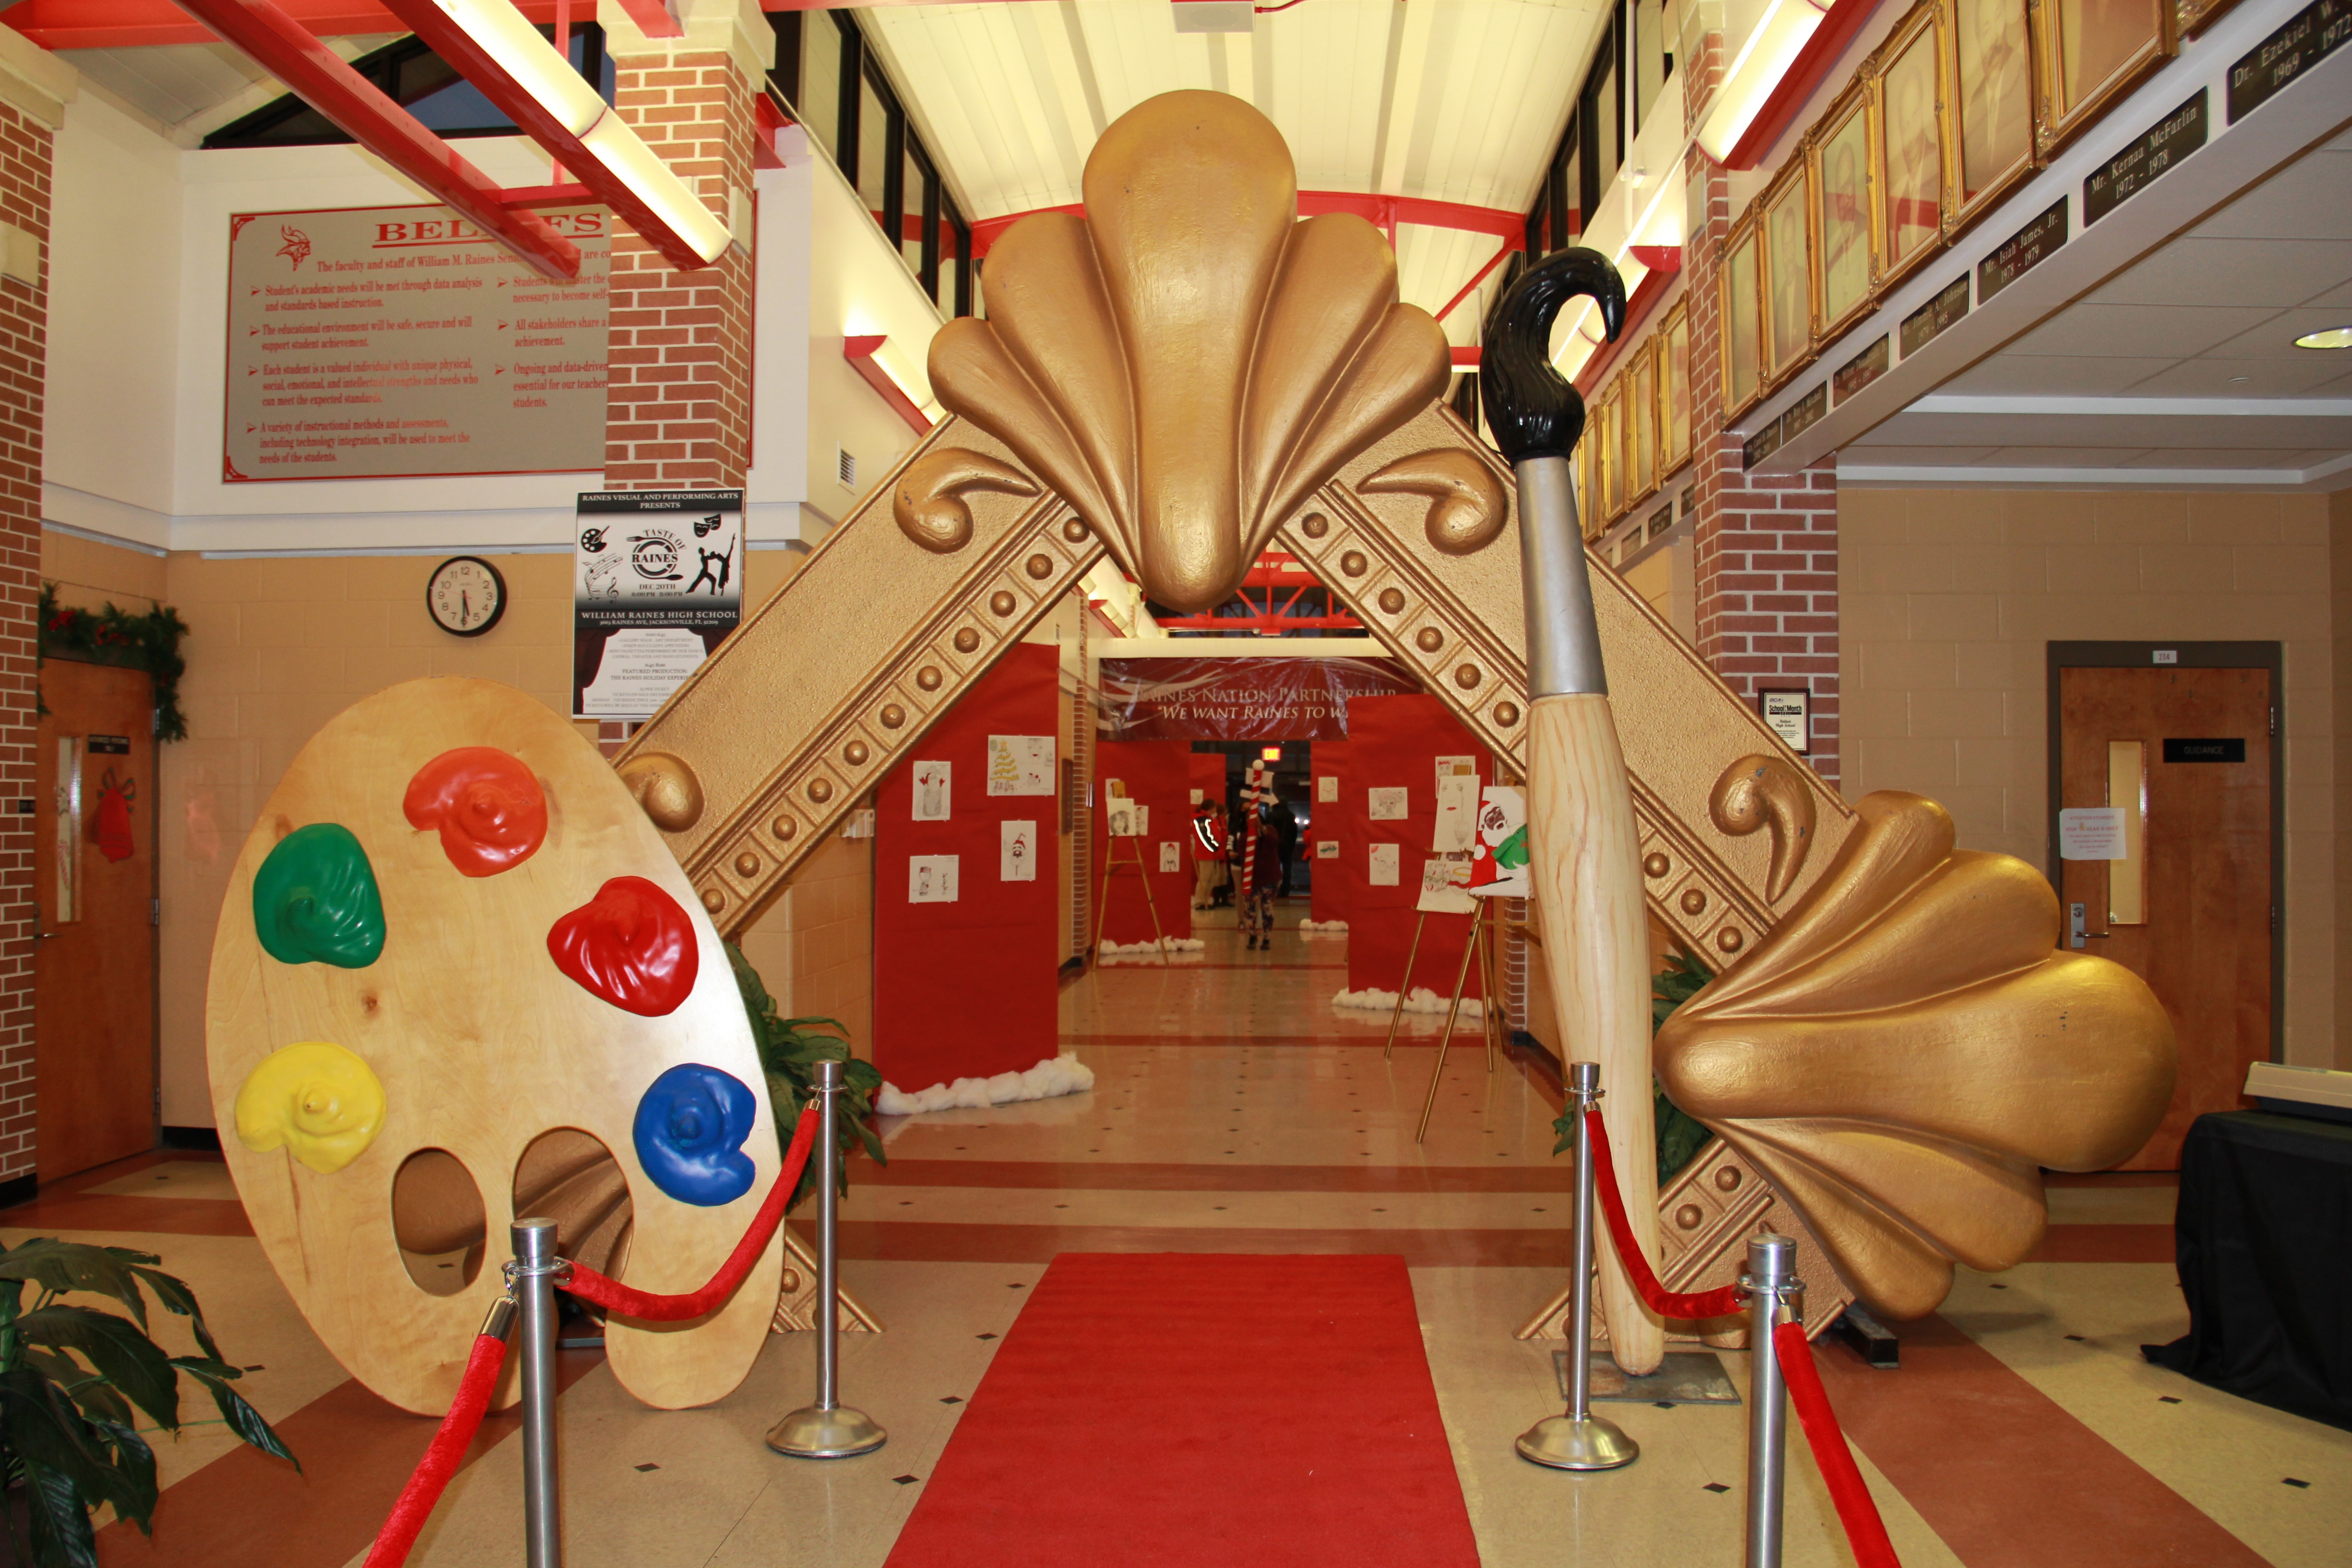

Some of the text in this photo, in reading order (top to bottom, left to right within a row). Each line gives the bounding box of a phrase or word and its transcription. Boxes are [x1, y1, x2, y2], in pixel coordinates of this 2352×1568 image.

[2234, 67, 2253, 88] Dr.
[2261, 15, 2311, 68] Ezekiel
[2273, 13, 2352, 86] 1969 1972
[2092, 107, 2197, 194] Mr. Kernaa McFarlin
[2116, 148, 2169, 199] 1972 1978
[375, 213, 602, 241] BELFS
[1985, 259, 1996, 276] Mr.
[1999, 242, 2016, 265] Isiah
[2048, 213, 2058, 228] Jr.
[318, 261, 333, 272] The
[335, 260, 364, 272] faculty
[367, 259, 383, 270] and
[386, 257, 406, 269] staff
[407, 257, 416, 268] of
[417, 255, 450, 267] William
[452, 255, 462, 265] M.
[465, 253, 495, 265] Raines
[498, 252, 522, 263] Senio
[584, 250, 598, 259] are
[2001, 245, 2039, 283] 1978 1979
[265, 277, 482, 295] Student's academic needs will be met through data analysis
[513, 273, 605, 287] Students the
[513, 289, 608, 304] necessary to become self-
[1944, 281, 1967, 306] Johnson
[515, 318, 526, 331] All
[528, 318, 576, 330] stakeholders
[578, 317, 600, 328] share
[262, 337, 369, 353] support student achievement.
[515, 335, 565, 347] achievement.
[514, 363, 546, 377] Ongoing
[548, 361, 562, 373] and
[263, 372, 479, 392] social, emotional, and intellectual strengths and needs who
[514, 379, 547, 391] essential
[549, 378, 560, 390] for
[562, 381, 575, 390] our
[513, 397, 548, 408] students.
[260, 421, 266, 432] A
[268, 421, 293, 434] variety
[295, 420, 303, 431] of
[304, 418, 351, 431] instructional
[353, 417, 384, 430] methods
[386, 417, 400, 429] and
[259, 452, 280, 464] needs
[282, 451, 289, 463] of
[291, 451, 302, 463] the
[643, 529, 686, 550] TASTE OF
[632, 554, 678, 563] RAINES
[451, 571, 457, 579] 11
[461, 567, 470, 575] 12
[441, 580, 490, 589] 10 2
[438, 591, 493, 600] 9 3
[442, 603, 449, 611] 8
[451, 612, 480, 621] 7 5
[461, 617, 468, 625] 6
[1137, 689, 1196, 702] RAINES
[1203, 688, 1270, 702] NATION
[1193, 707, 1239, 719] WANT
[1244, 706, 1298, 719] RAINES
[1304, 707, 1325, 718] TO
[1264, 749, 1279, 760] EXIT
[2184, 746, 2224, 755] GUIDANCE
